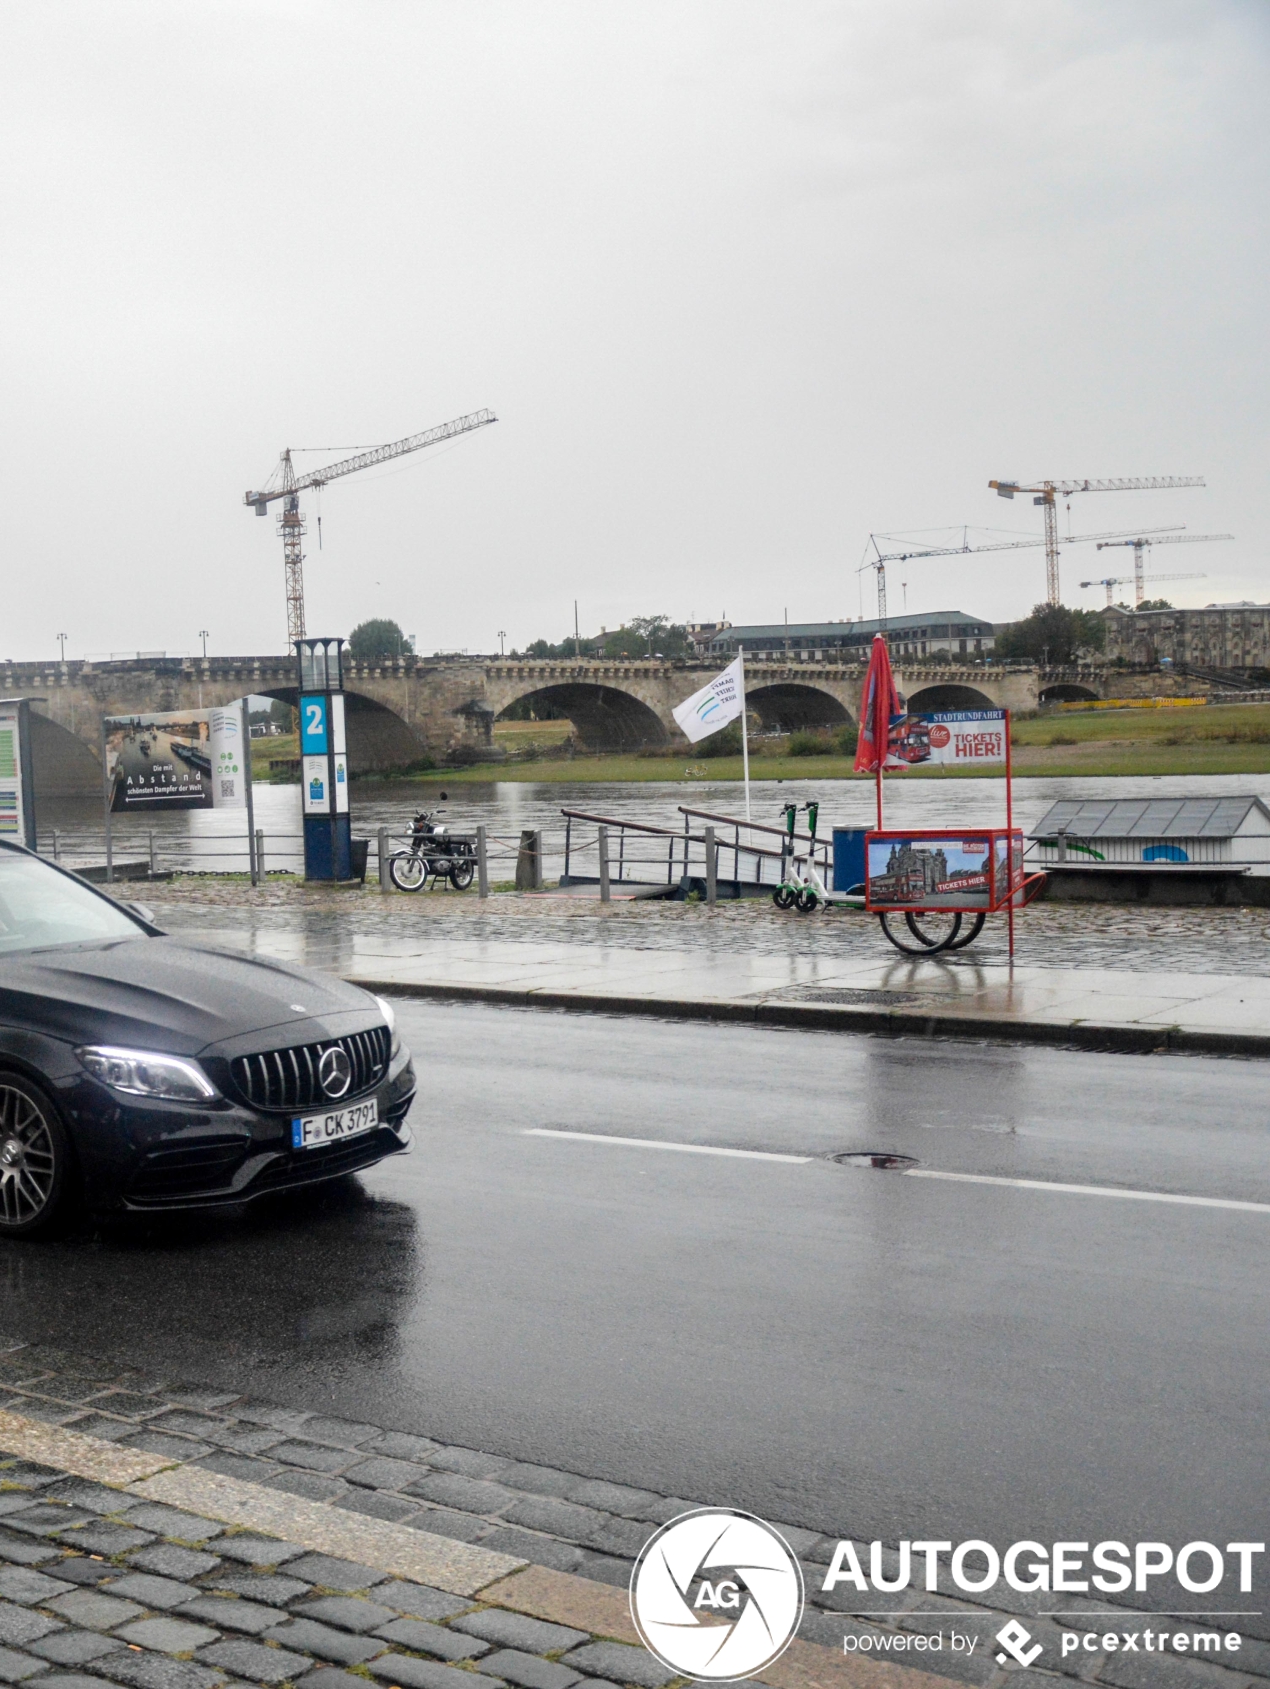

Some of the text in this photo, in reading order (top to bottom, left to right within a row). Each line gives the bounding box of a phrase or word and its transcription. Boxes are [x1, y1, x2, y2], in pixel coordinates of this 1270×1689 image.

[306, 705, 324, 735] 2
[933, 710, 1003, 722] STADTRUNDFAHRT
[954, 732, 1002, 744] TICKETS
[955, 741, 1002, 758] HIER!
[127, 787, 154, 795] schönsten
[154, 785, 177, 794] Dampfer
[938, 876, 985, 891] TICKETS HIER
[303, 1120, 313, 1142] F
[325, 1113, 344, 1136] CK
[347, 1102, 376, 1131] 3791
